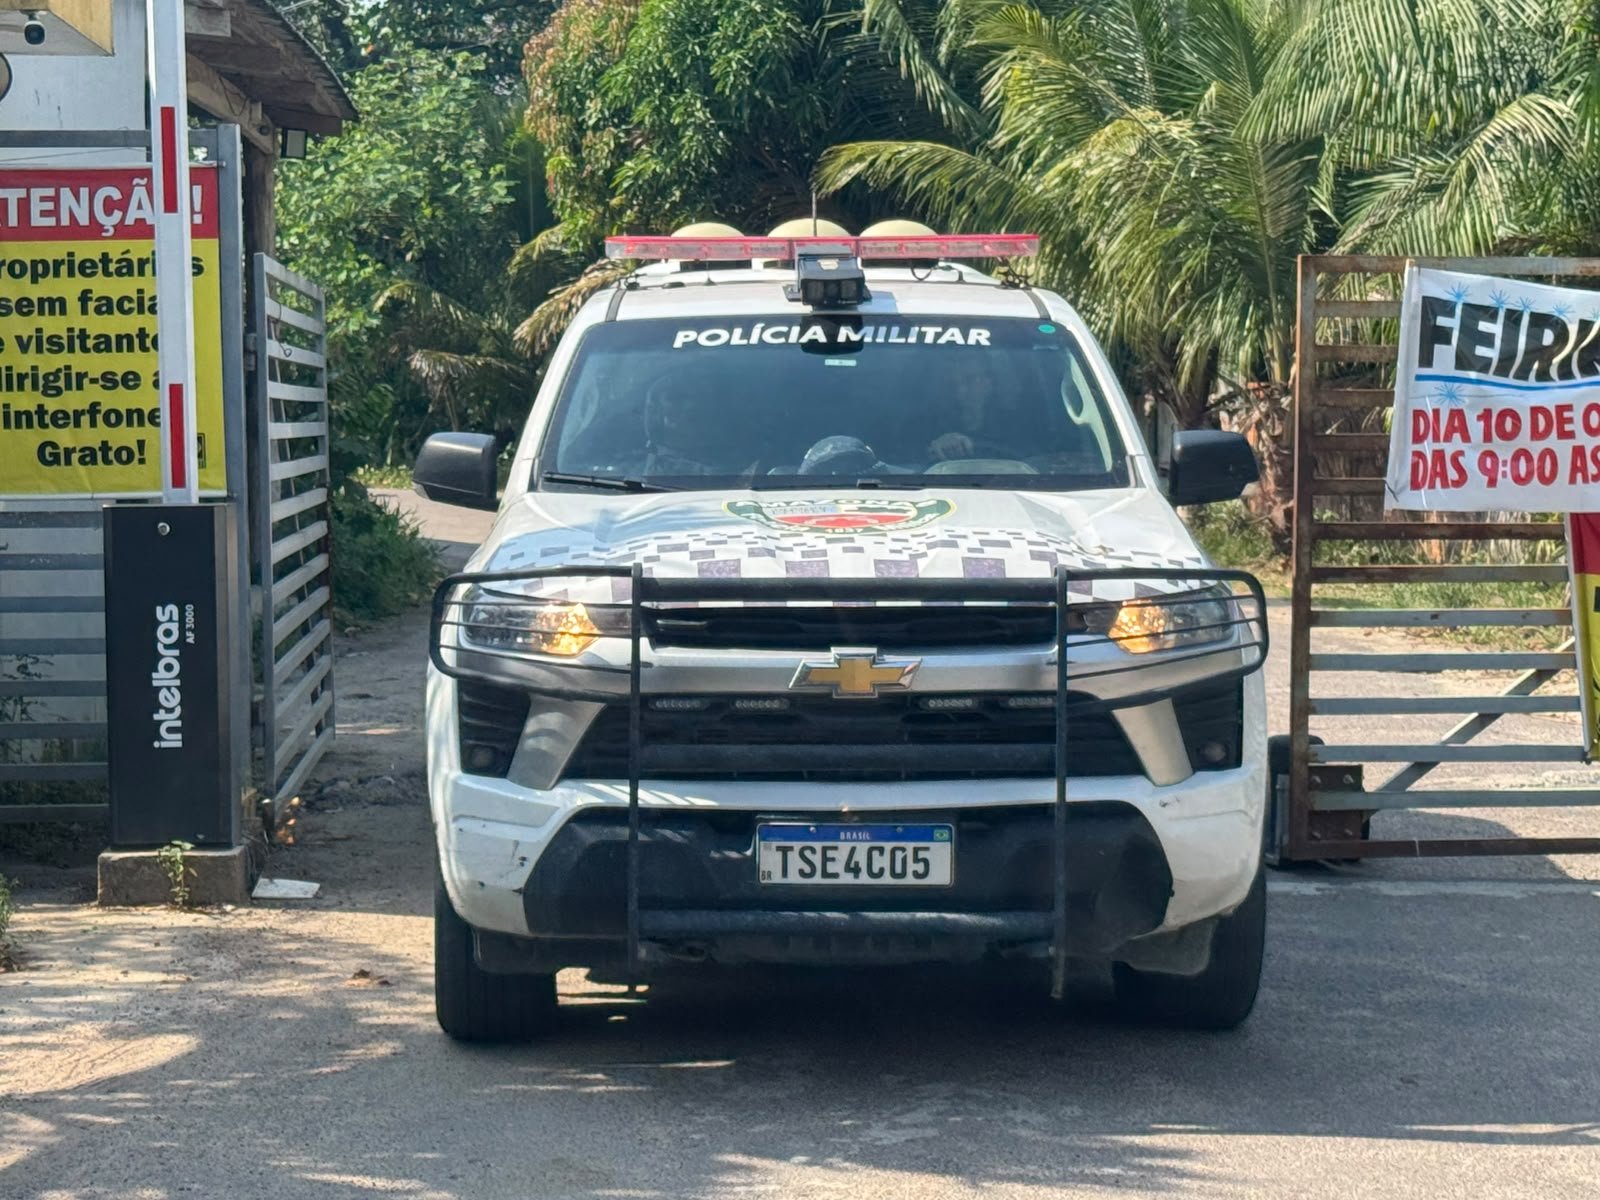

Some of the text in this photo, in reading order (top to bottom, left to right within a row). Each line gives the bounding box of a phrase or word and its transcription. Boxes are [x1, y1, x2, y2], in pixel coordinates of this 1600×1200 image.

[0, 178, 203, 237] TENÇÃ!
[0, 249, 205, 284] oprietáris
[0, 297, 67, 317] sem
[672, 323, 991, 349] POLÍCIA MILITAR
[1418, 296, 1600, 382] FEIRI
[0, 364, 142, 398] irigir-se
[1411, 408, 1472, 445] DIA
[1476, 408, 1522, 444] 10
[1529, 404, 1576, 442] DE
[37, 438, 147, 467] Grato!
[1409, 449, 1468, 491] DAS
[1477, 447, 1559, 488] 9:00
[185, 603, 195, 645] AF 3000
[152, 603, 183, 748] intelbras
[839, 831, 871, 841] BRASIL
[775, 845, 931, 880] TSE4C05
